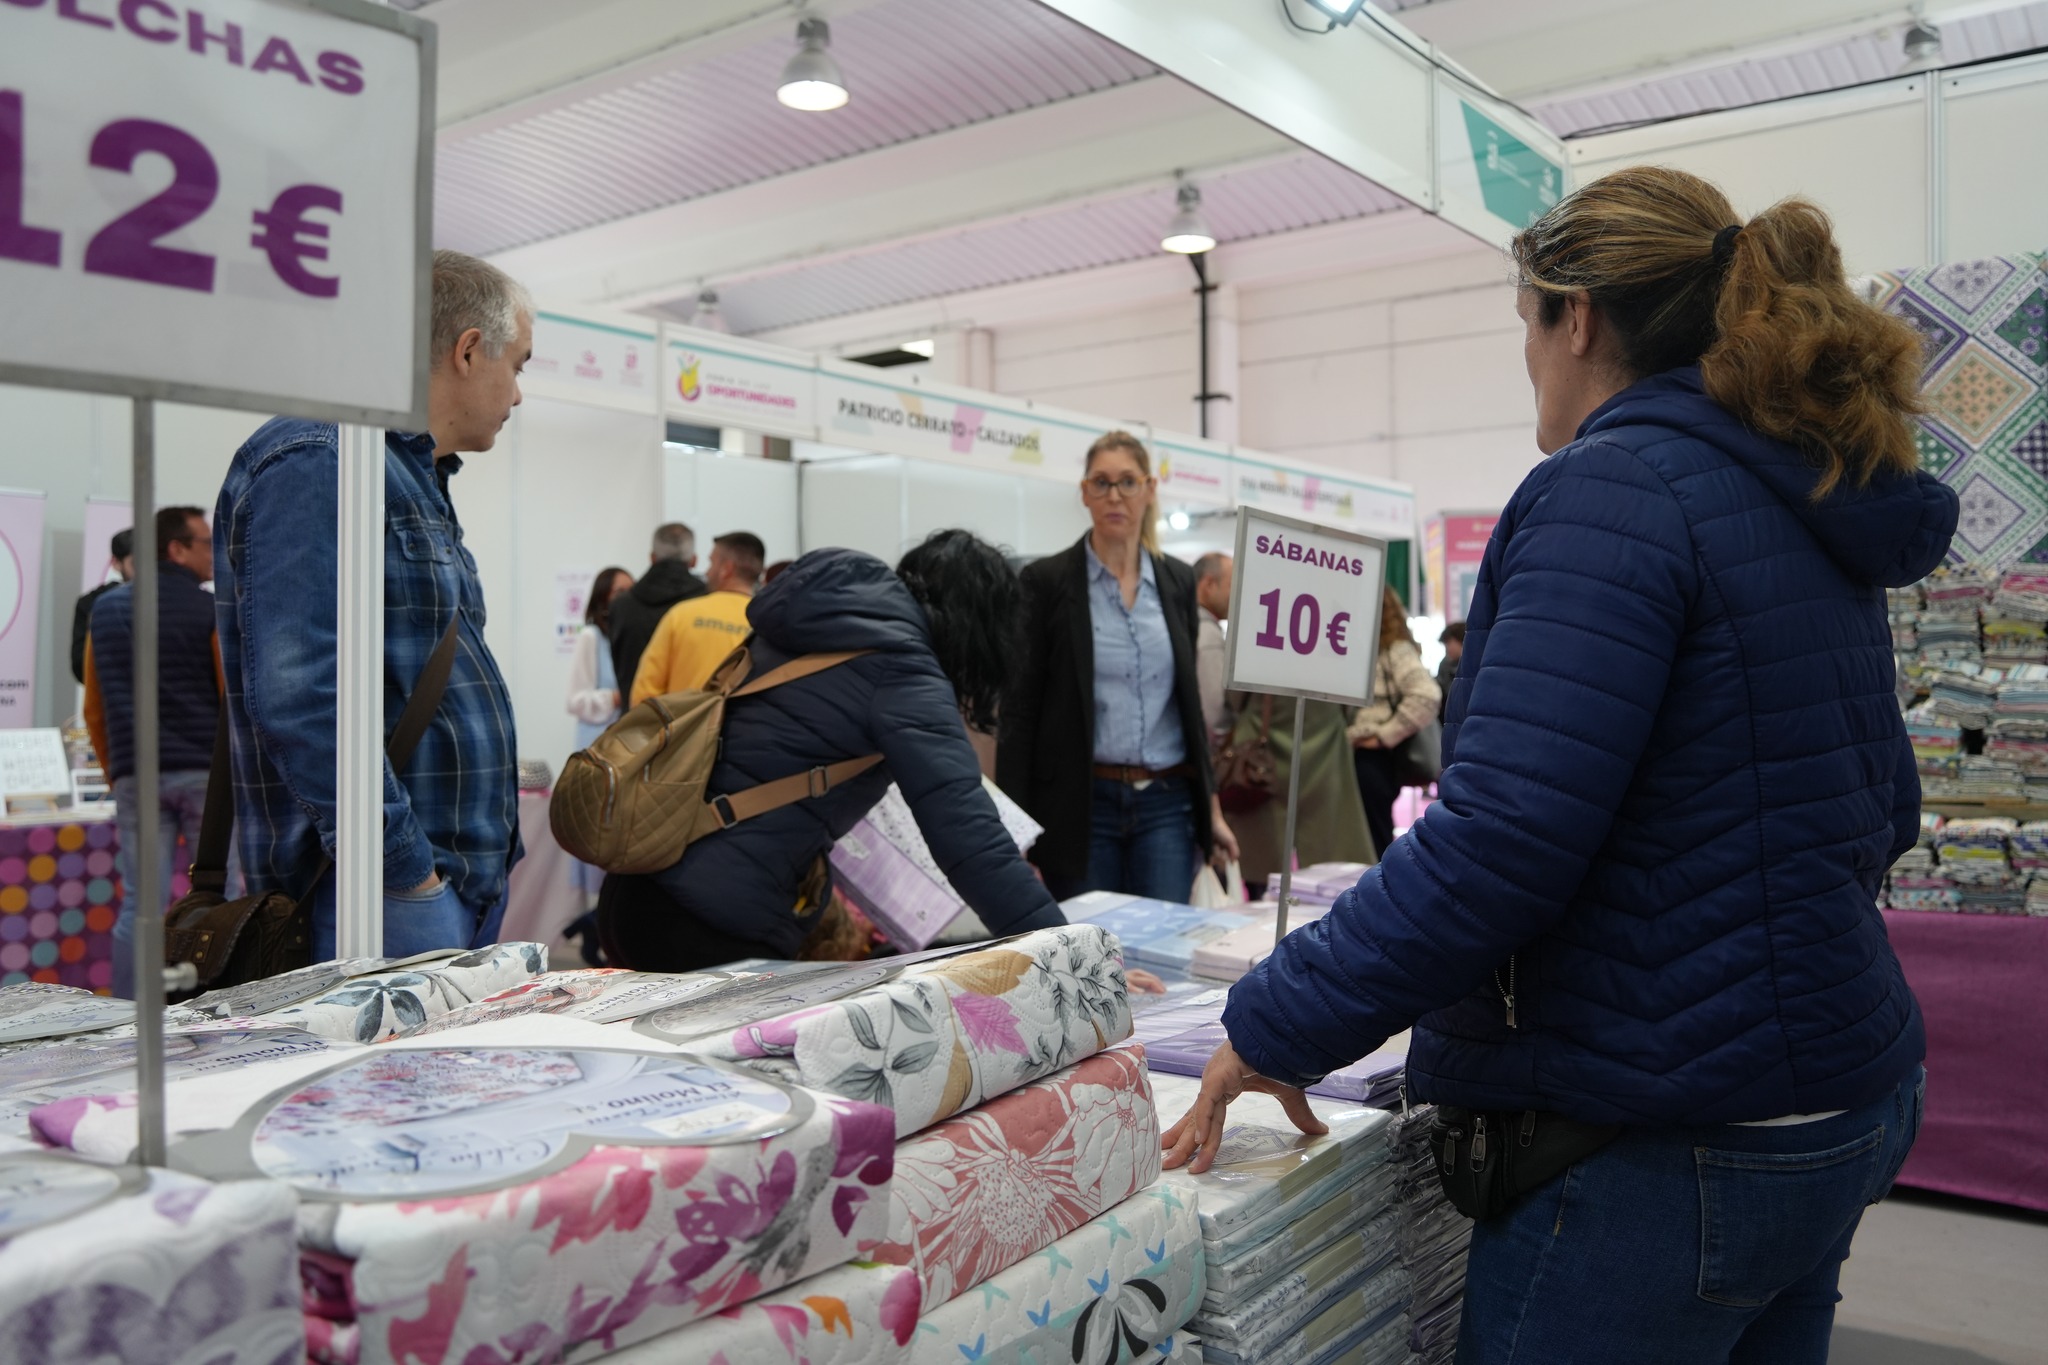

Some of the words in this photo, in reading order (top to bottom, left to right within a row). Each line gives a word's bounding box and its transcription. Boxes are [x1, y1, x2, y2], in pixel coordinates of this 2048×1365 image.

[838, 398, 904, 427] PATRICIO
[976, 426, 1040, 452] CALZADOS
[1256, 535, 1363, 577] SÁBANAS
